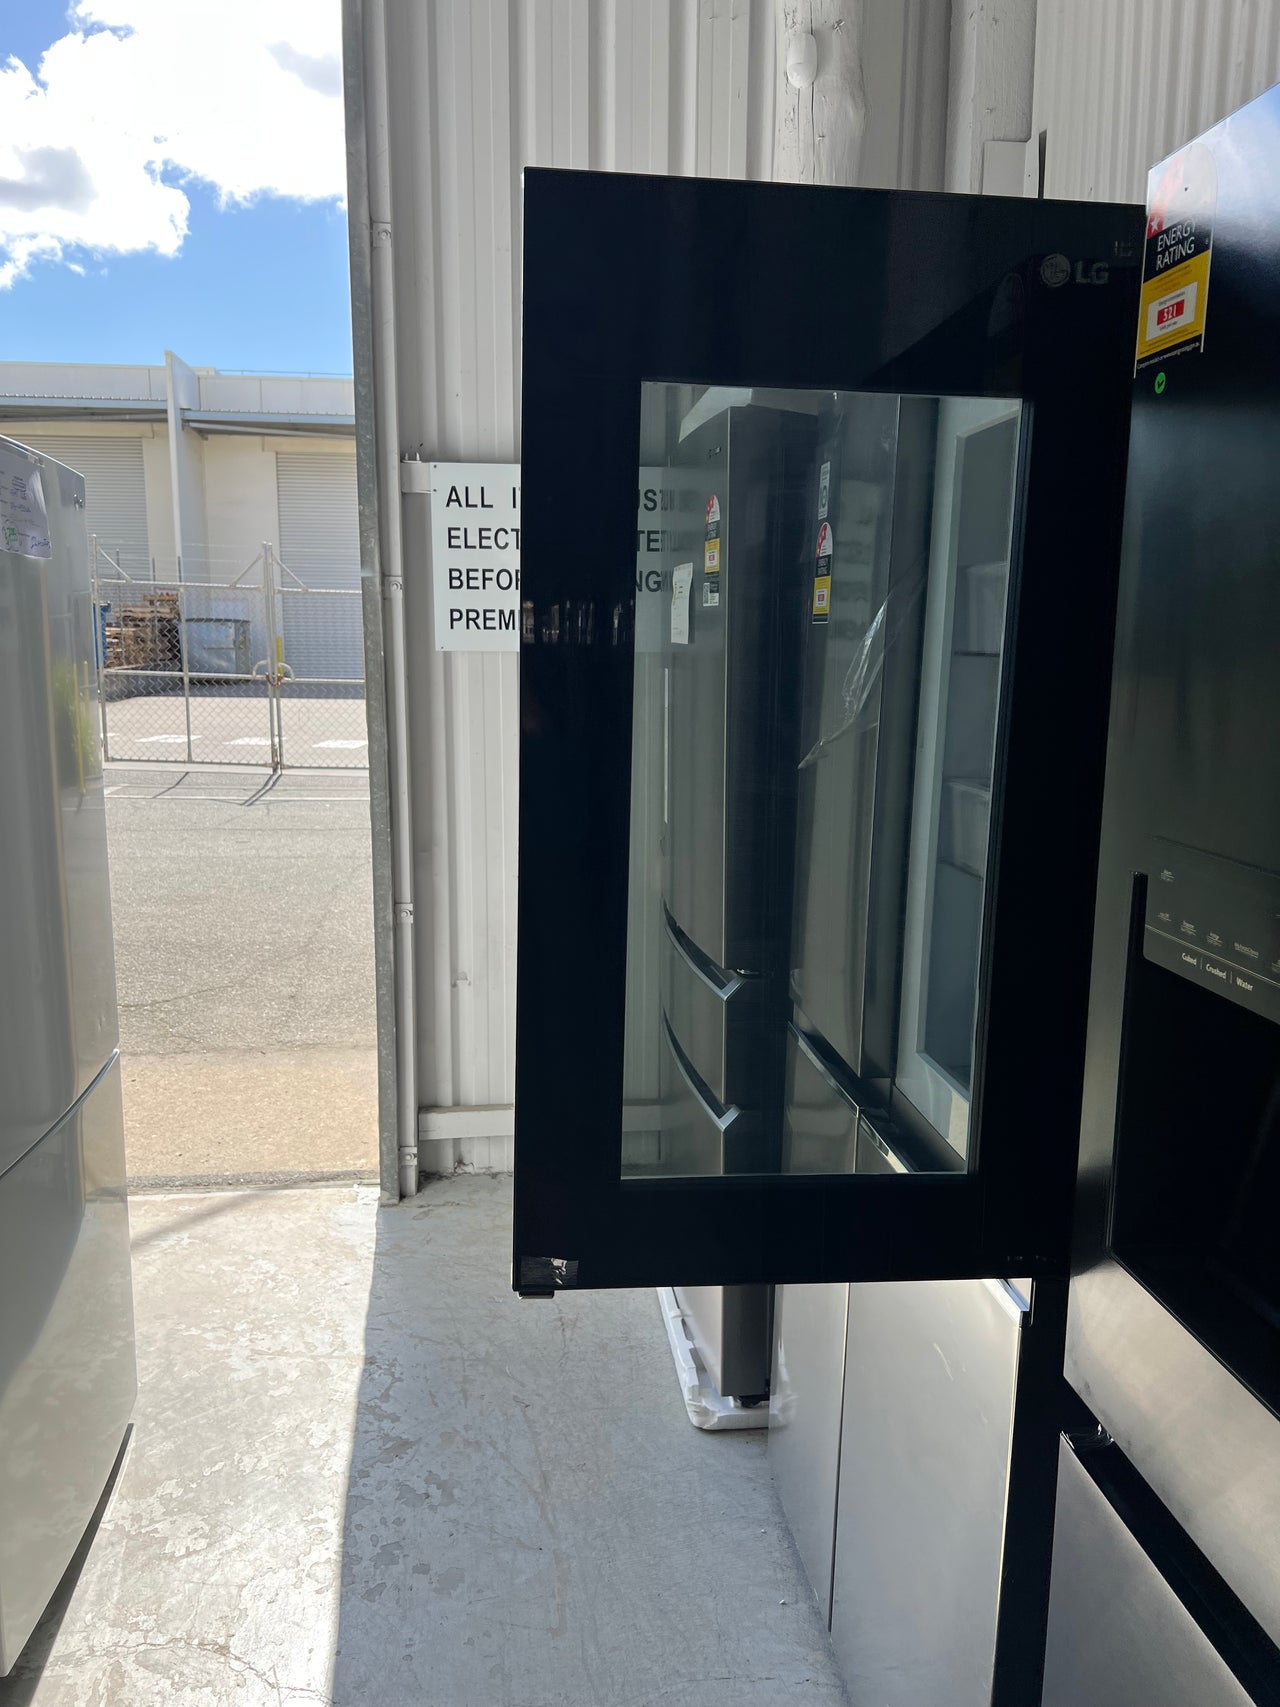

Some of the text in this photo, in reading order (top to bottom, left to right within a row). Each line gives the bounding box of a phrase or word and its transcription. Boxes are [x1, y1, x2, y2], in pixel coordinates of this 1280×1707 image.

[1155, 236, 1195, 271] RATING
[1075, 260, 1110, 284] LG
[445, 486, 494, 508] ALL
[1205, 963, 1228, 980] Crushed
[1236, 976, 1254, 992] Water
